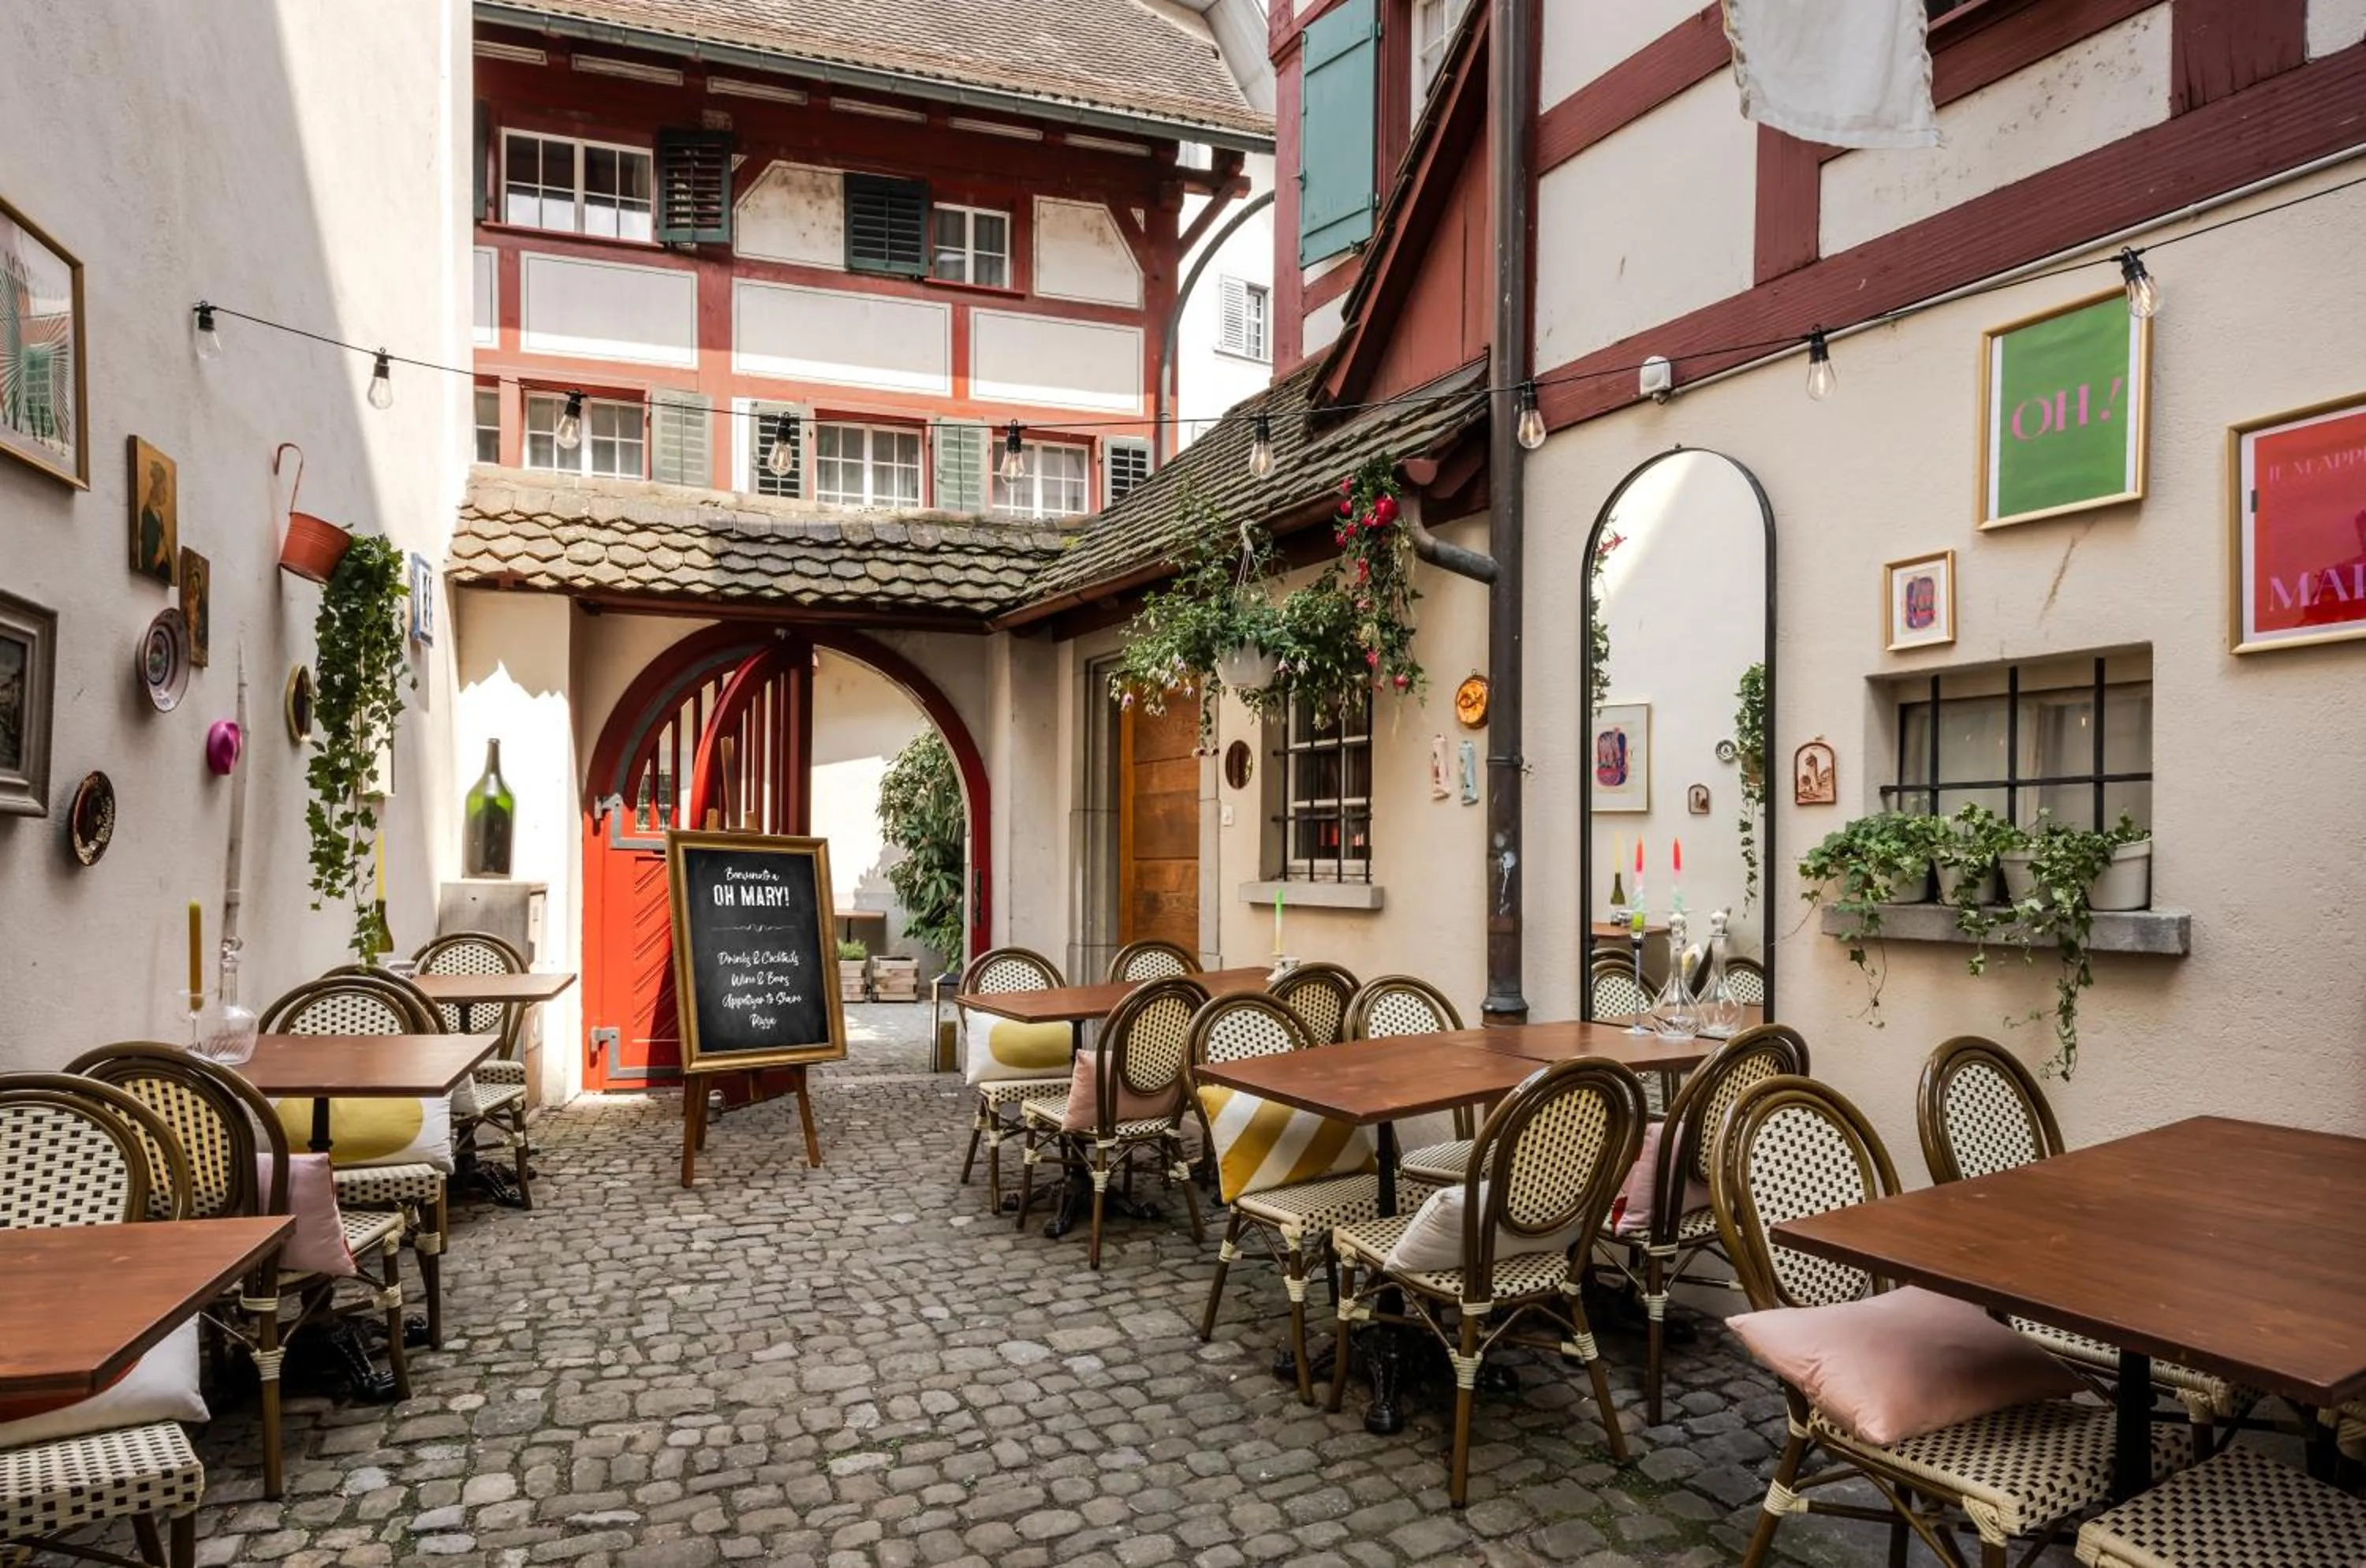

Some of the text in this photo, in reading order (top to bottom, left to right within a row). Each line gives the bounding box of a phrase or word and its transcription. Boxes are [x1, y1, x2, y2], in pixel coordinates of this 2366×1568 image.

[714, 884, 789, 906] OH MARY!
[717, 950, 800, 968] Drinks & Cocktails
[756, 971, 765, 985] &
[765, 992, 774, 1005] to
[748, 1014, 777, 1029] Pizza
